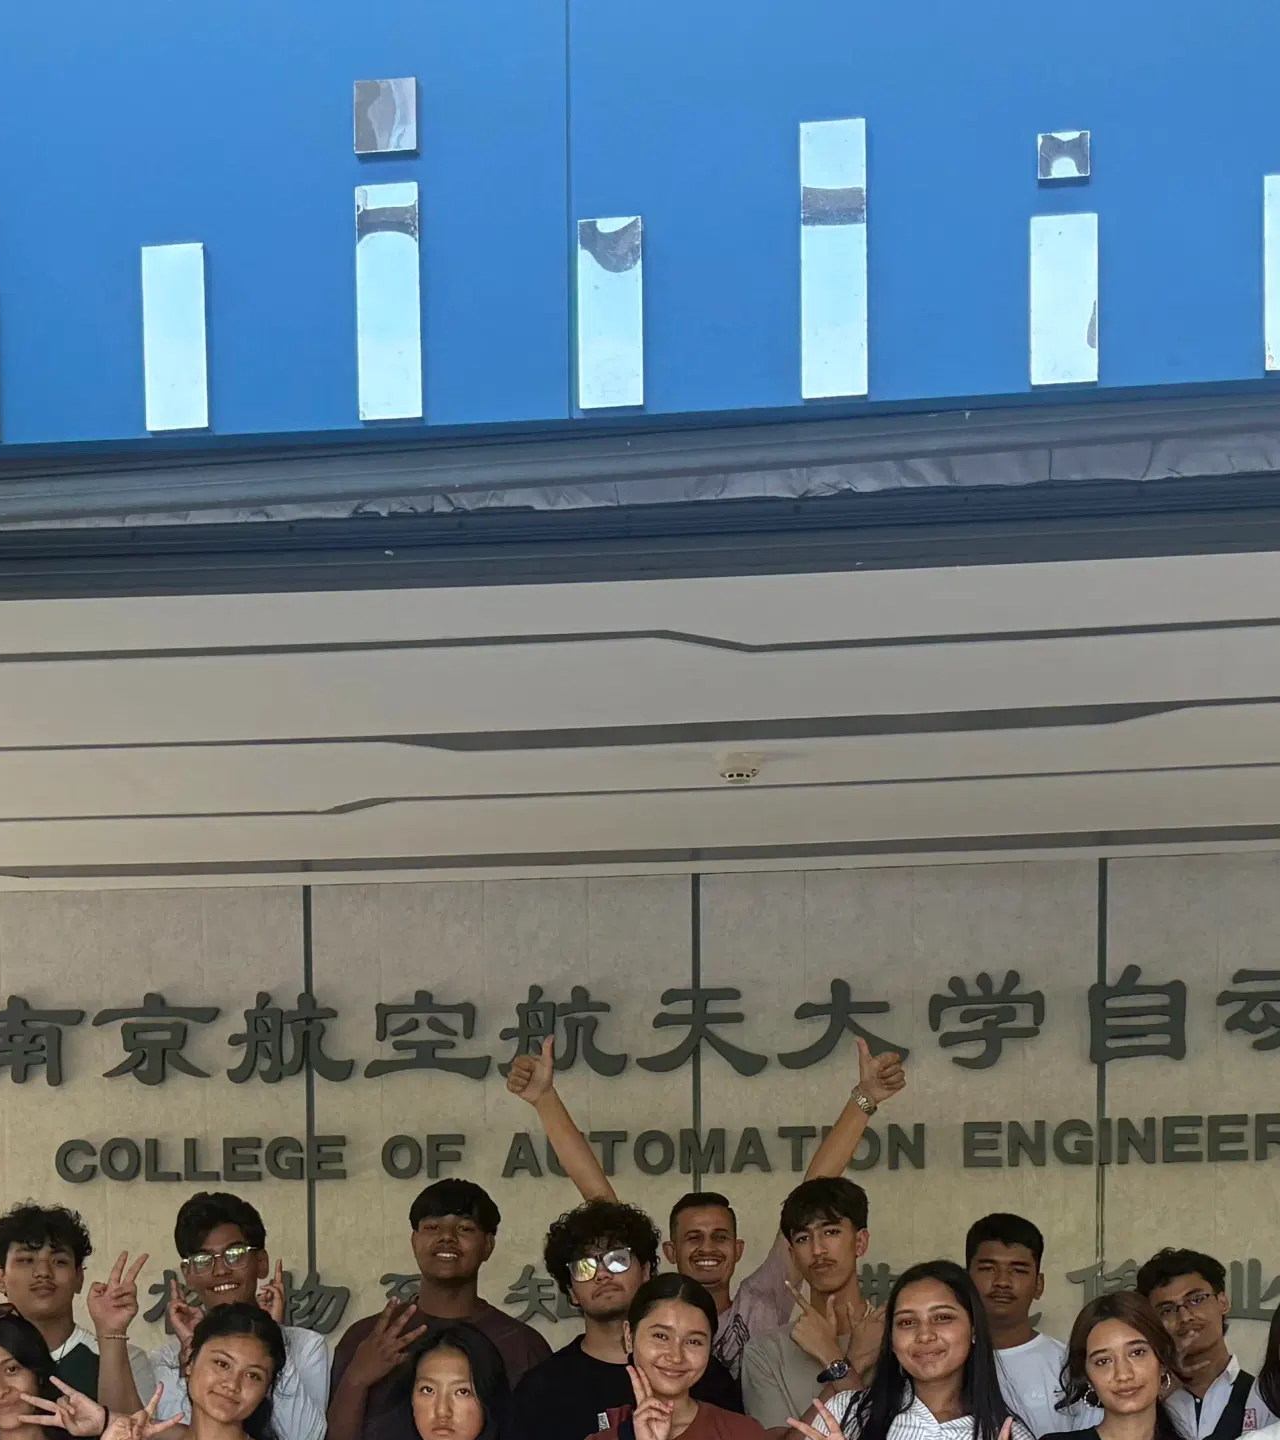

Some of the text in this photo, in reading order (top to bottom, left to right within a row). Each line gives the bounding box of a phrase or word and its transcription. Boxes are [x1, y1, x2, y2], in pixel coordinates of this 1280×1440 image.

[54, 1133, 348, 1184] COLLEGE
[381, 1131, 466, 1180] OF
[501, 1122, 926, 1178] ATOMATON
